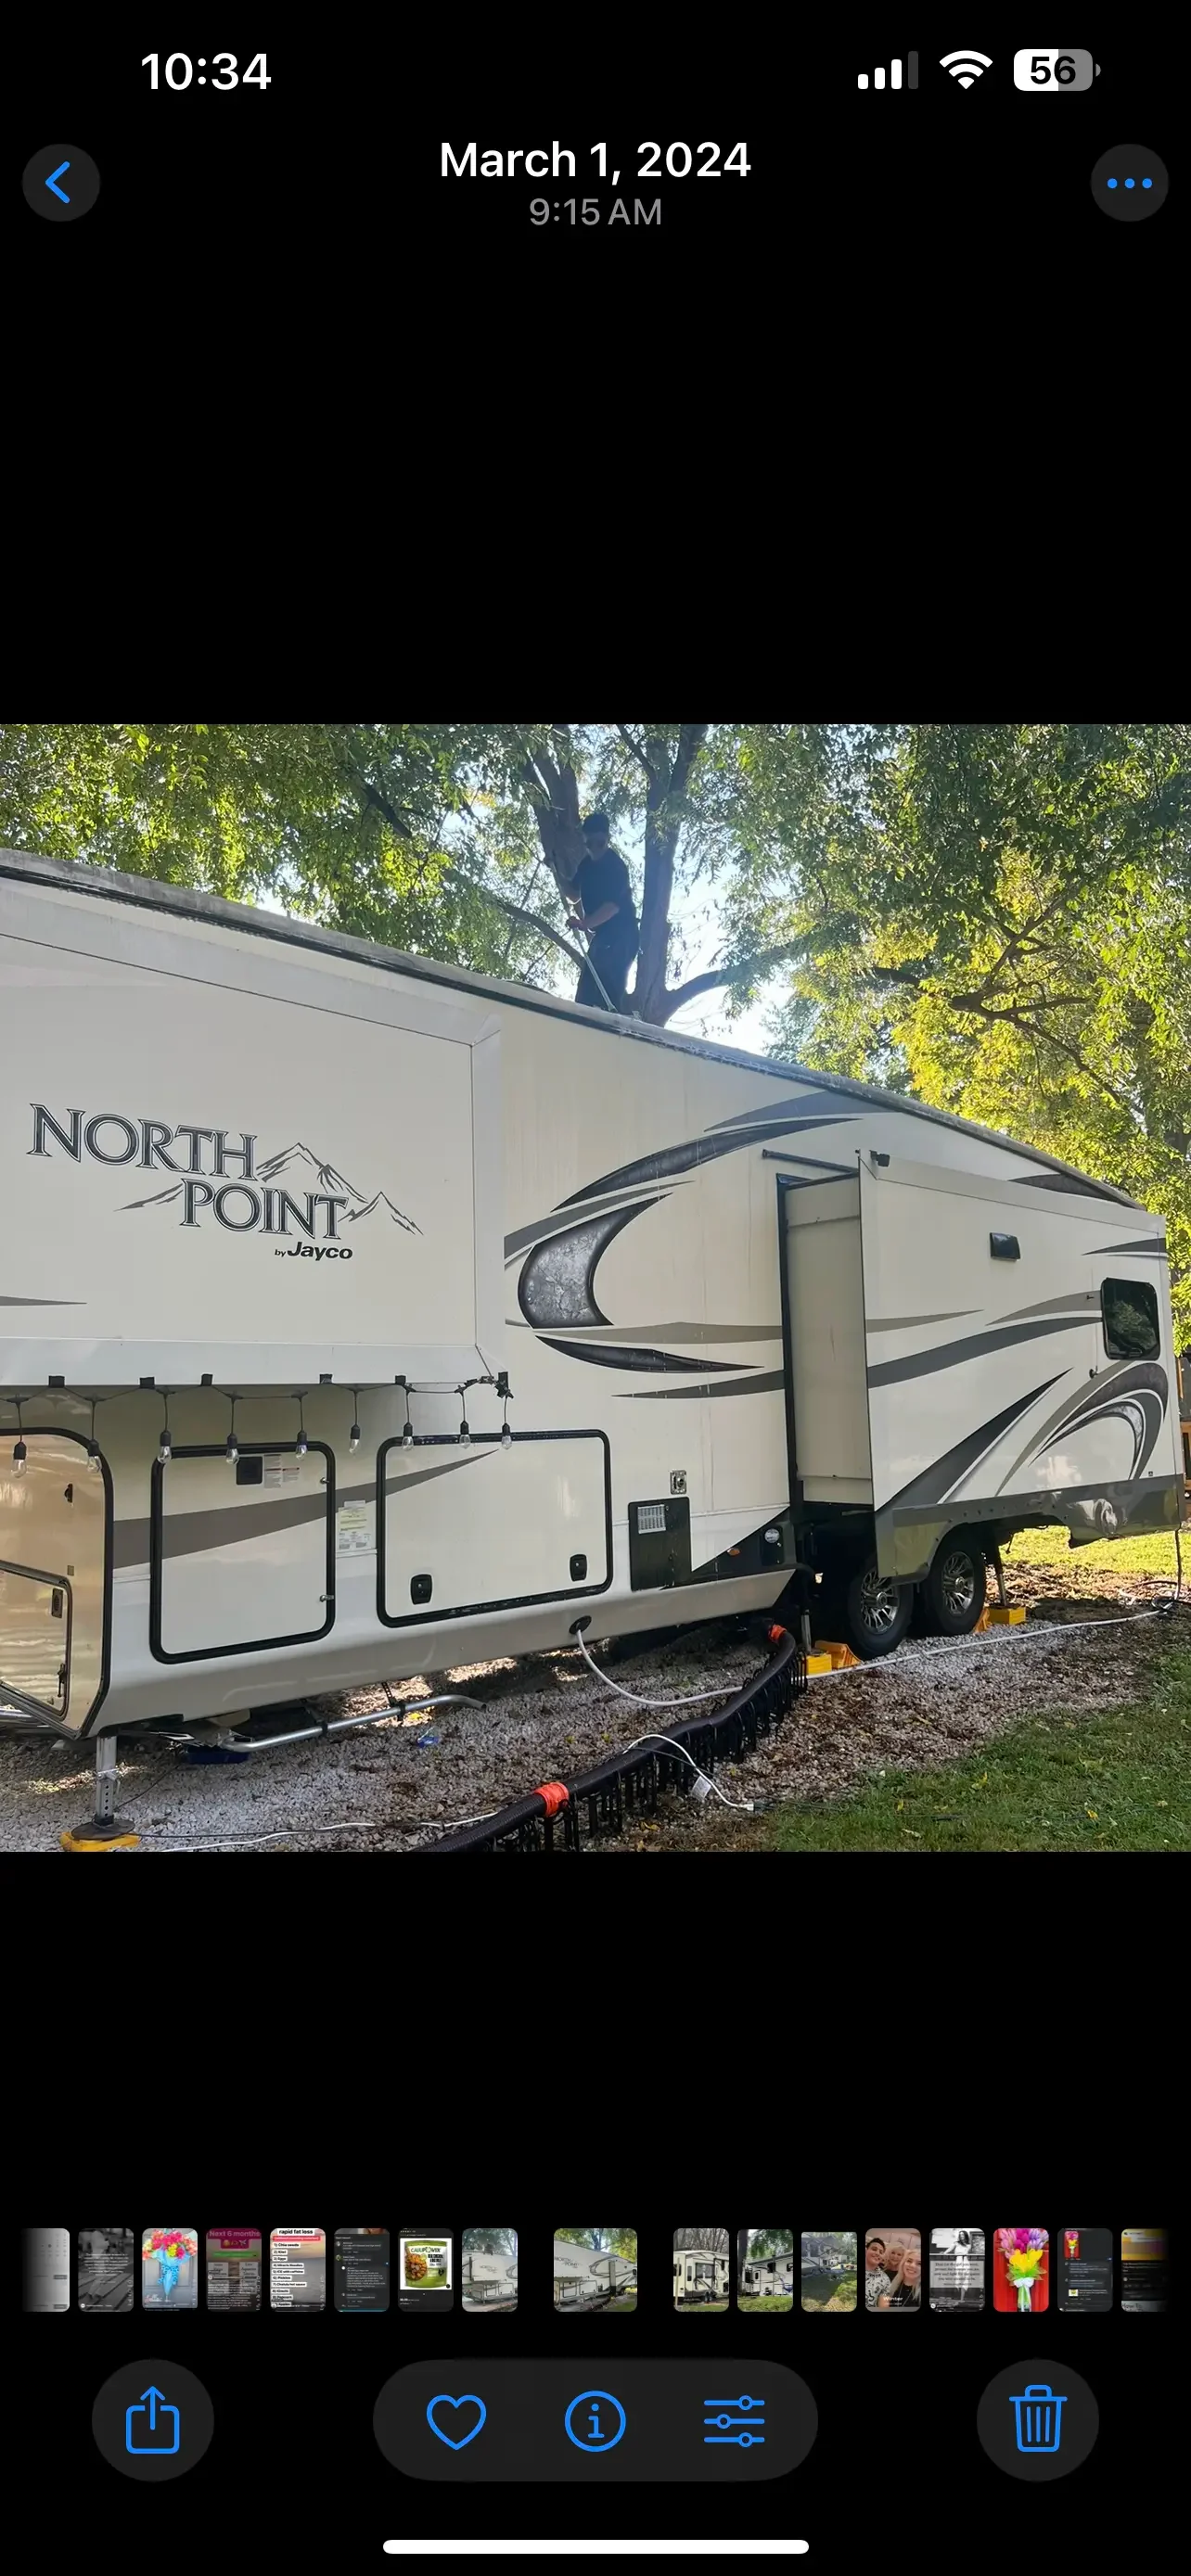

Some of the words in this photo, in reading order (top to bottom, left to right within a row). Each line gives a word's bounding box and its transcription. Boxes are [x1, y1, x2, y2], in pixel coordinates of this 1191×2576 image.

[26, 1103, 258, 1182] NORTH
[179, 1177, 350, 1241] POINT
[274, 1248, 287, 1257] by
[287, 1241, 353, 1261] Jayco
